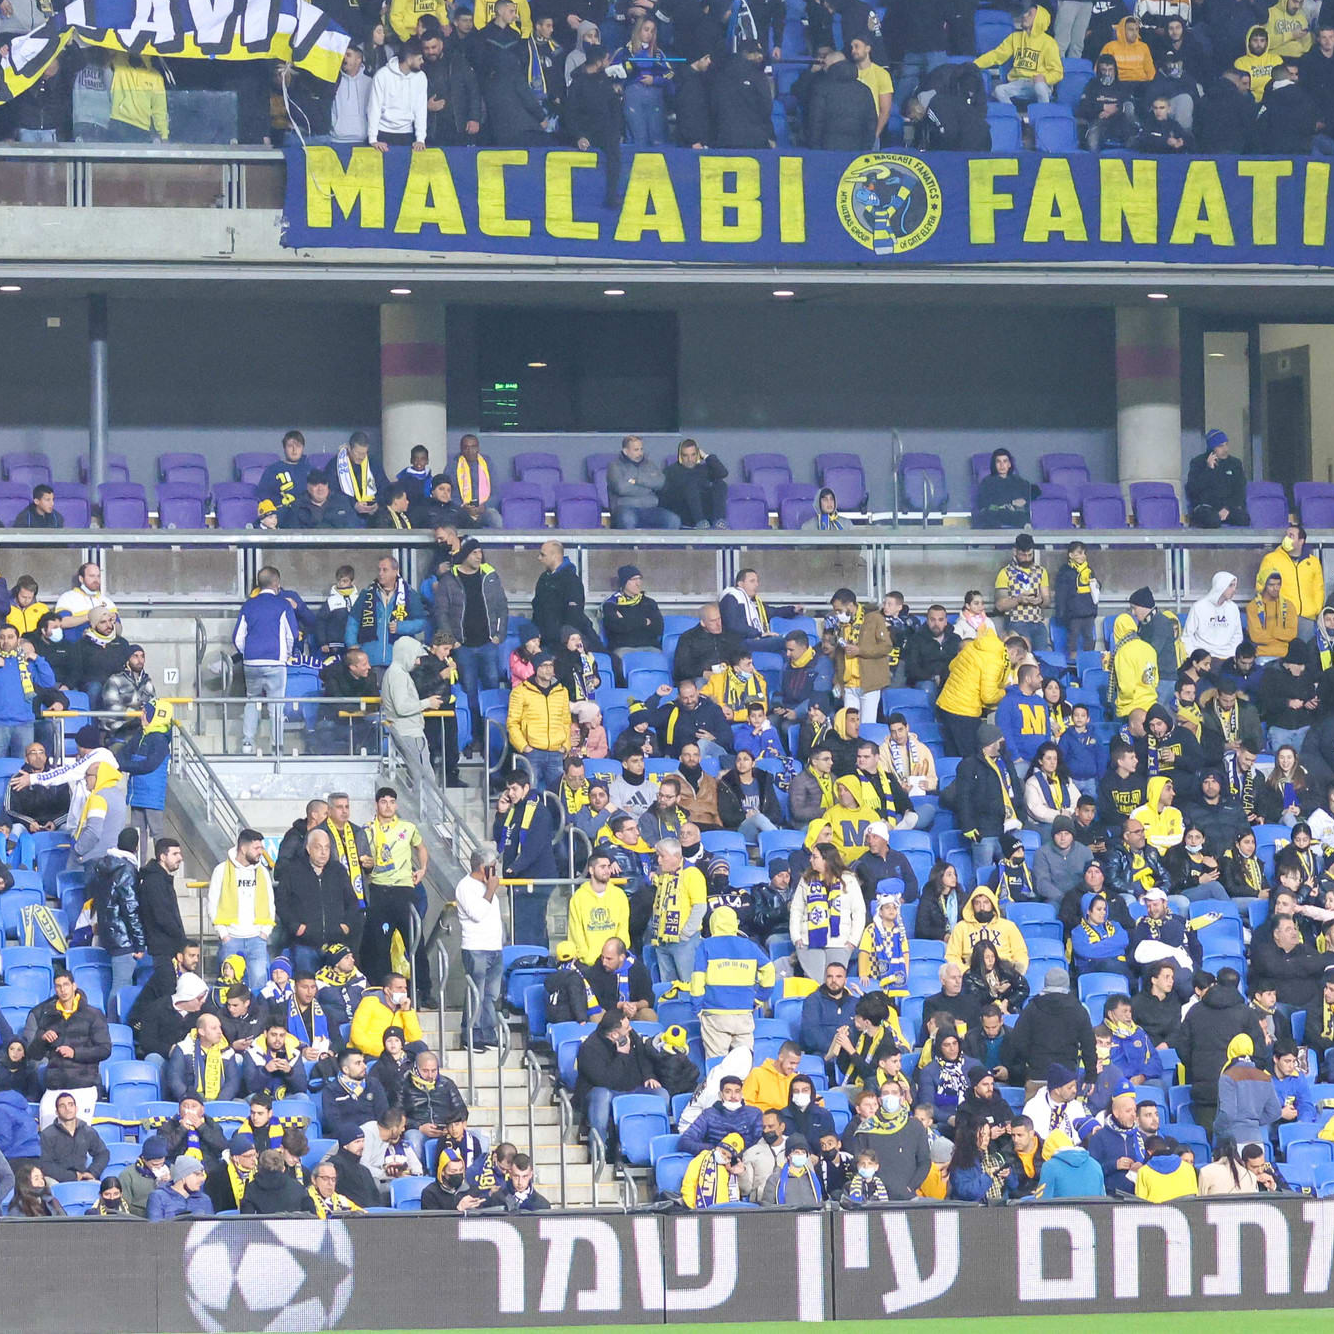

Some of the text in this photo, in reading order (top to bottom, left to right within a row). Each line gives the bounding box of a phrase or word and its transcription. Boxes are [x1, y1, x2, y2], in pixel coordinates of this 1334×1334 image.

[873, 154, 939, 200] MACCABI FANATICS
[305, 146, 806, 243] MACCABI
[851, 225, 871, 242] GROUP
[907, 234, 922, 247] GATE
[920, 215, 937, 236] ELEVEN
[167, 672, 176, 681] 17
[1019, 704, 1046, 735] M
[349, 848, 357, 867] CLUB
[970, 931, 1002, 947] FOX
[458, 1215, 739, 1313] שמר
[796, 1209, 960, 1322] עין
